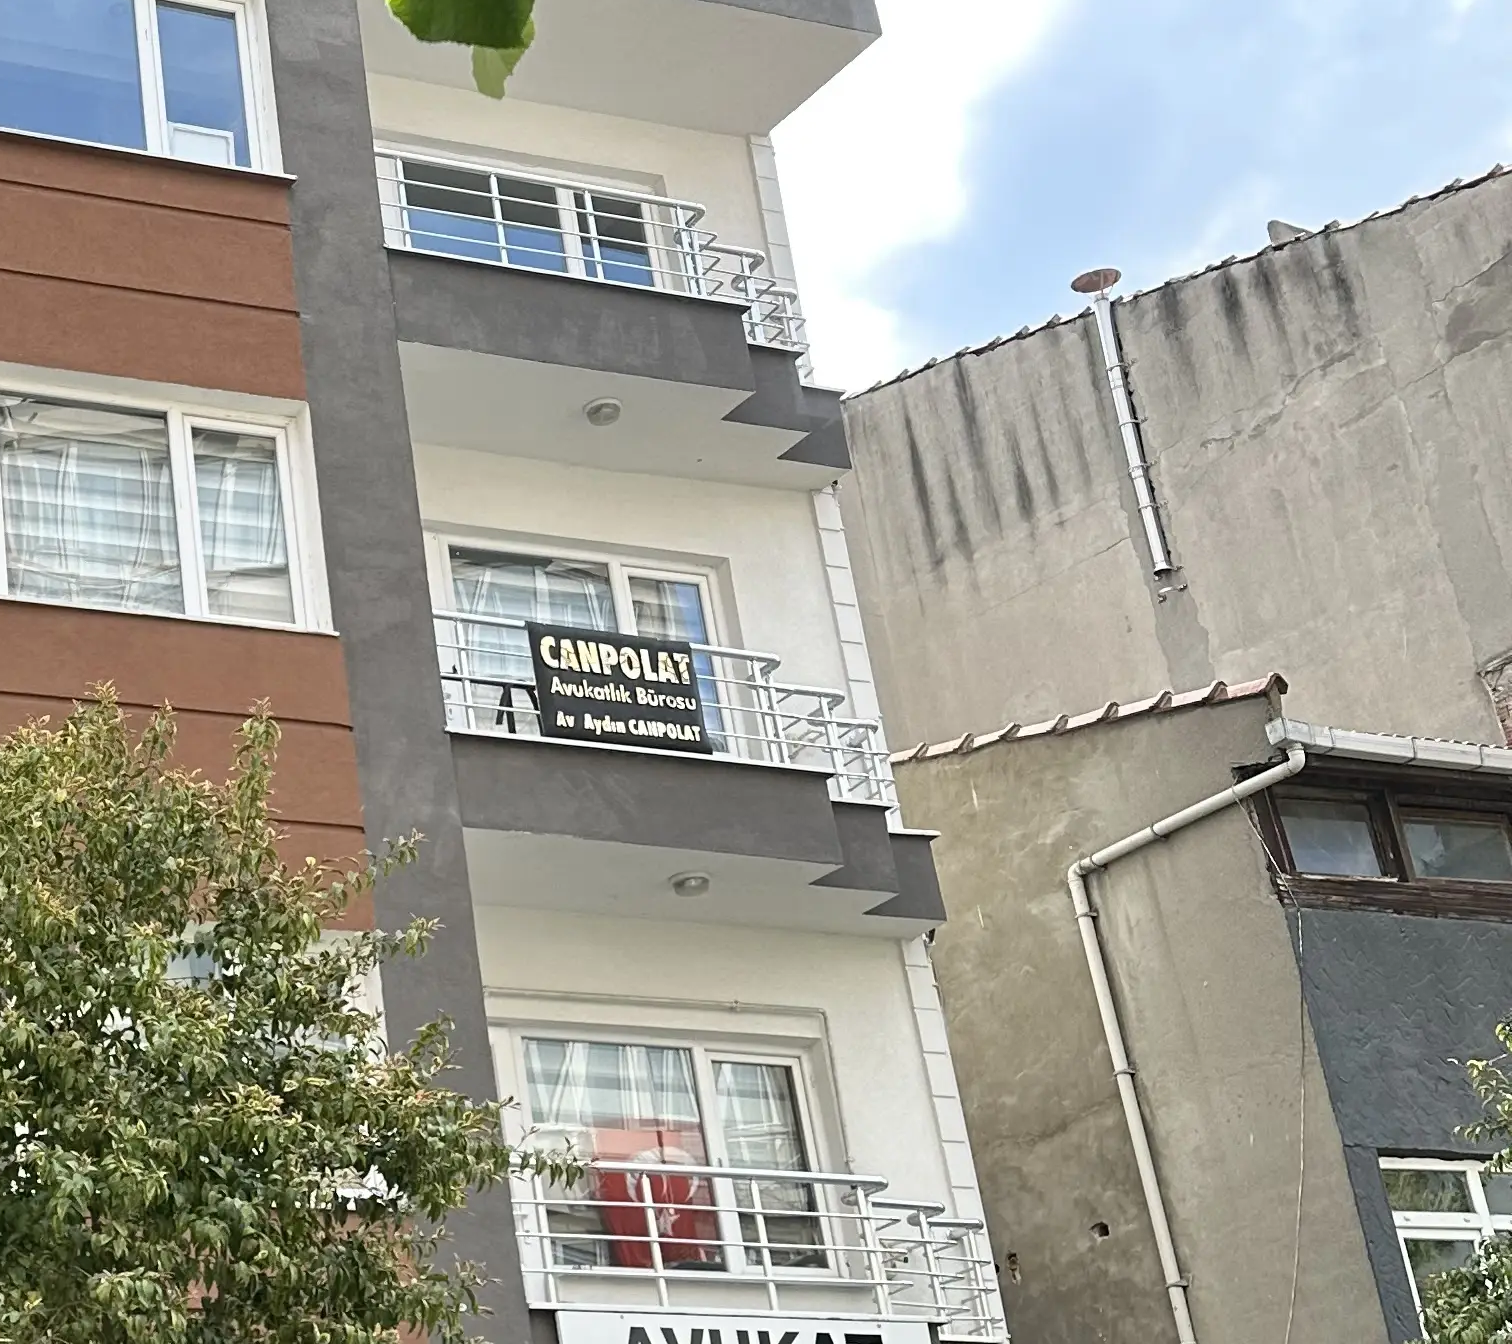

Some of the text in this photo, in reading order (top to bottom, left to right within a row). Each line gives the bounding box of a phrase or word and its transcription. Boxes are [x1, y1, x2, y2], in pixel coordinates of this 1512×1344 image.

[540, 636, 691, 684] CANPOLAT
[551, 676, 696, 710] Avukatlık Bürosu
[584, 713, 626, 735] Aydın
[629, 719, 701, 741] CANPOLAT
